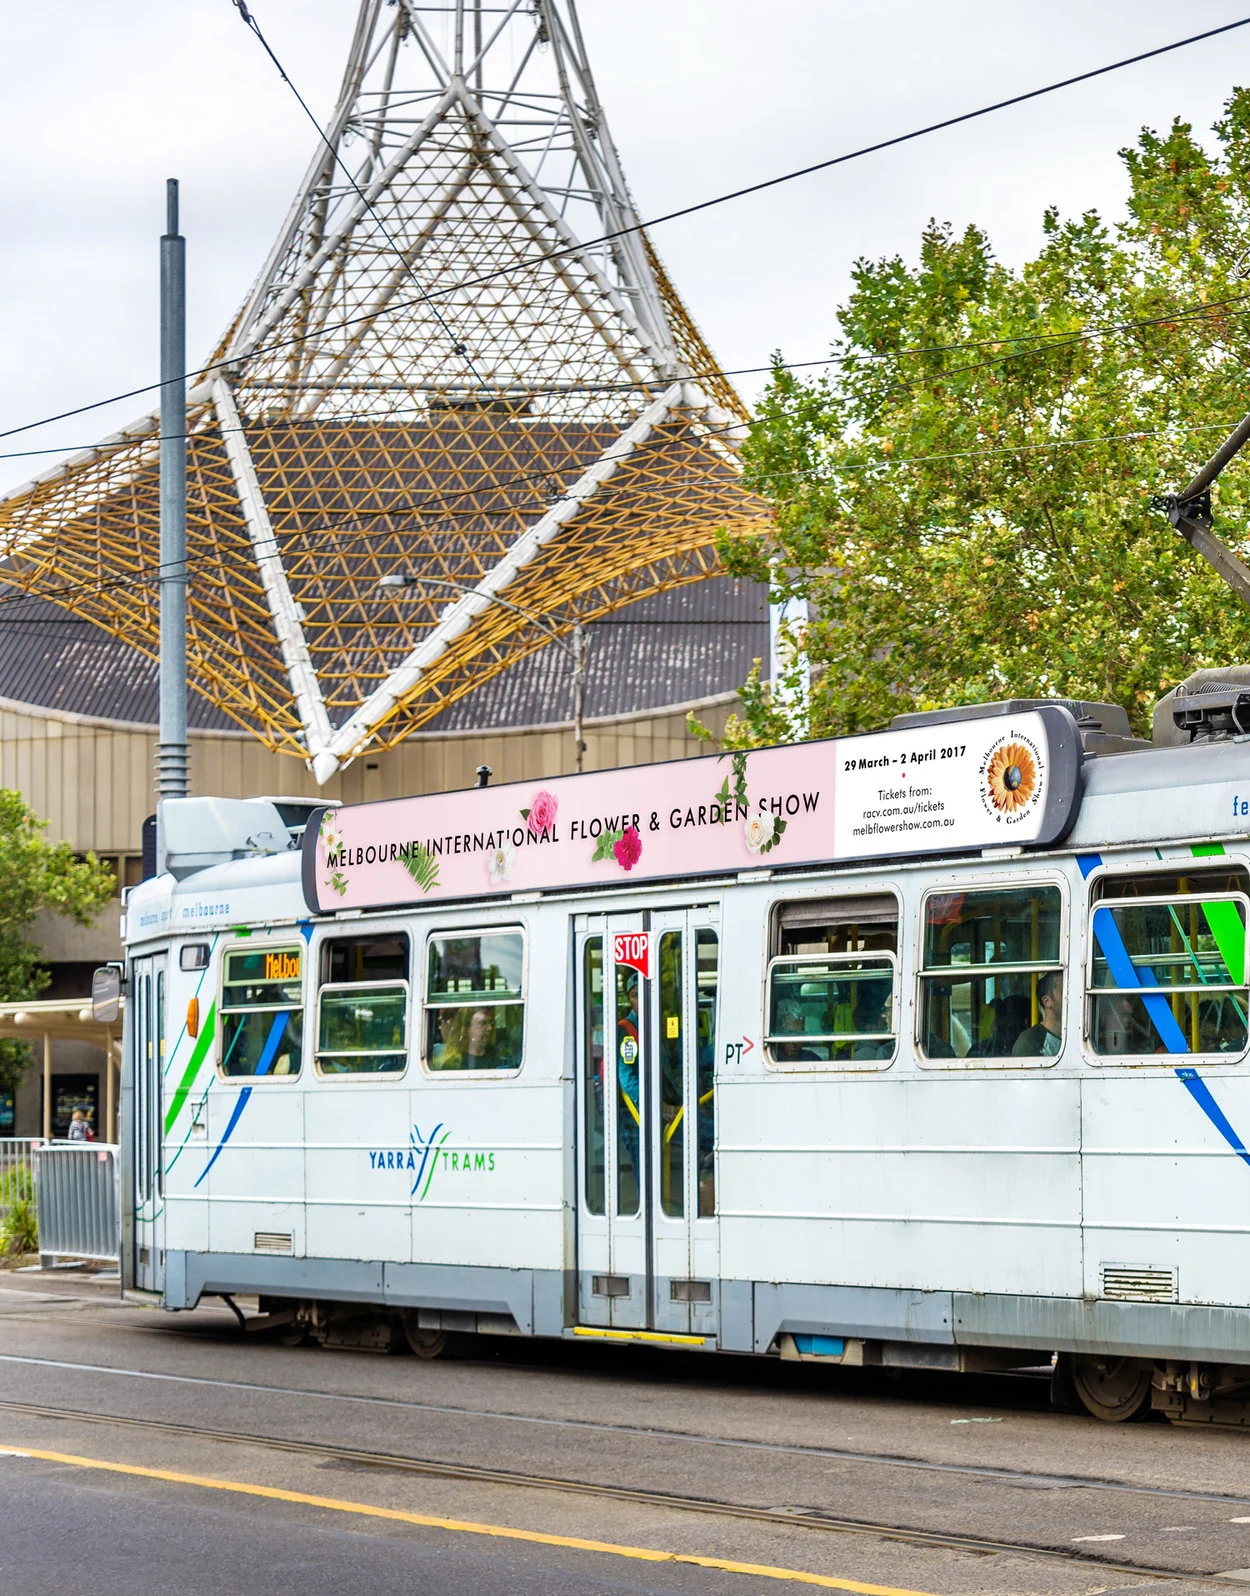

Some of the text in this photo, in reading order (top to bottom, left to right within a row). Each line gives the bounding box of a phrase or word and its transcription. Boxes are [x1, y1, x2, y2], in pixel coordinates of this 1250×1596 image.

[844, 760, 857, 772] 29
[858, 753, 890, 770] March
[900, 753, 907, 765] 2
[910, 749, 937, 767] April
[940, 745, 966, 760] 2017
[979, 730, 1044, 775] Melbourne International
[878, 786, 933, 801] Tickets from:
[980, 787, 993, 815] Flower
[1006, 809, 1031, 824] Garden
[1032, 781, 1043, 805] Show
[862, 800, 945, 819] racv.com.au/tickets
[326, 840, 419, 868] MELBOURNE
[570, 813, 641, 840] FLOWER
[649, 811, 661, 831] &
[669, 801, 748, 829] GARDEN
[759, 791, 820, 818] SHOW
[852, 816, 955, 837] melbflowershow.com.au
[182, 902, 230, 918] melbourne
[615, 935, 648, 961] STOP
[369, 1151, 495, 1171] YARRA TRAMS
